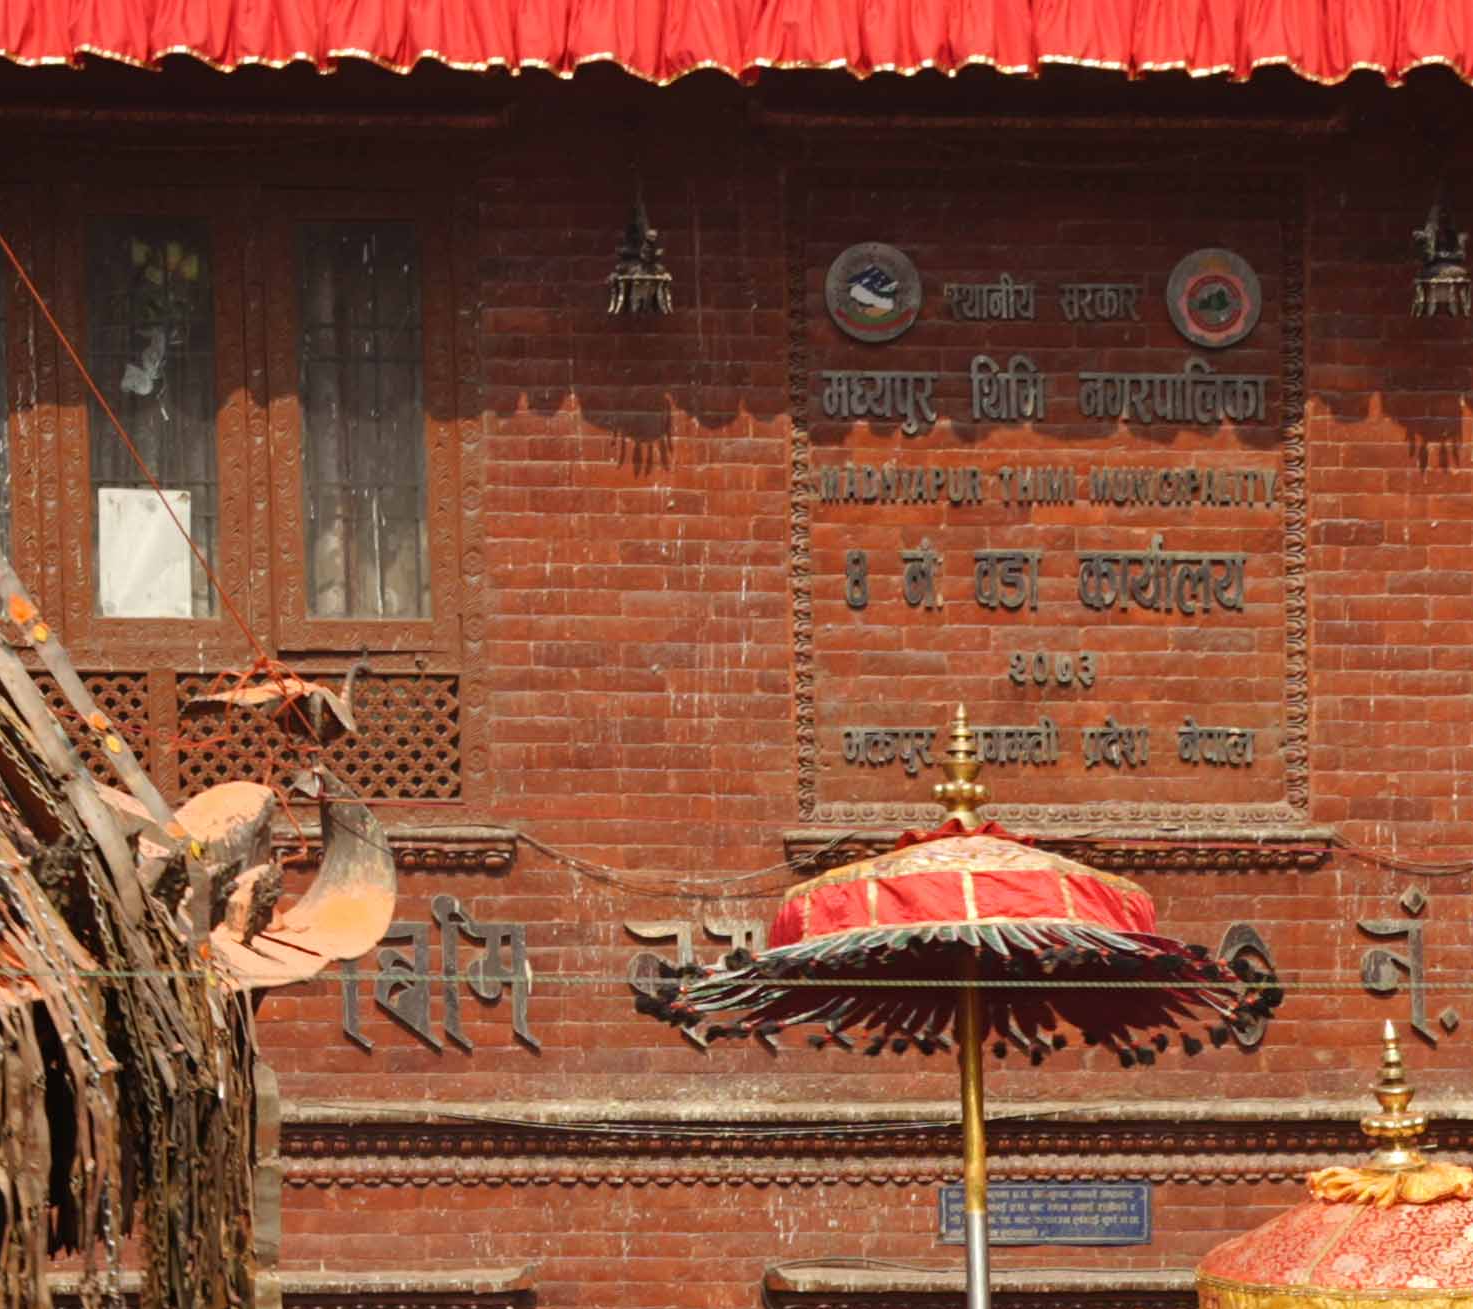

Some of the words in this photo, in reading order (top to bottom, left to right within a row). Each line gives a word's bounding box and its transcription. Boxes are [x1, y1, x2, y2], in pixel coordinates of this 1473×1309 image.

[945, 274, 1036, 320] स्थानीय
[1059, 283, 1141, 320] सरकार
[821, 371, 938, 435] मध्यपुर
[970, 354, 1049, 421] थिमि
[1079, 357, 1271, 424] नगरपालिका
[820, 464, 984, 504] MADHYAPUR
[998, 466, 1076, 504] THIMI
[1089, 466, 1279, 508] MUNICIPALITY
[974, 549, 1041, 610] वडा
[1078, 533, 1247, 613] कार्यालय
[1007, 651, 1097, 687] २०७३
[841, 726, 937, 775] भक्तपुर
[1082, 716, 1149, 767] प्रदेश
[1177, 715, 1255, 767] नेपाल
